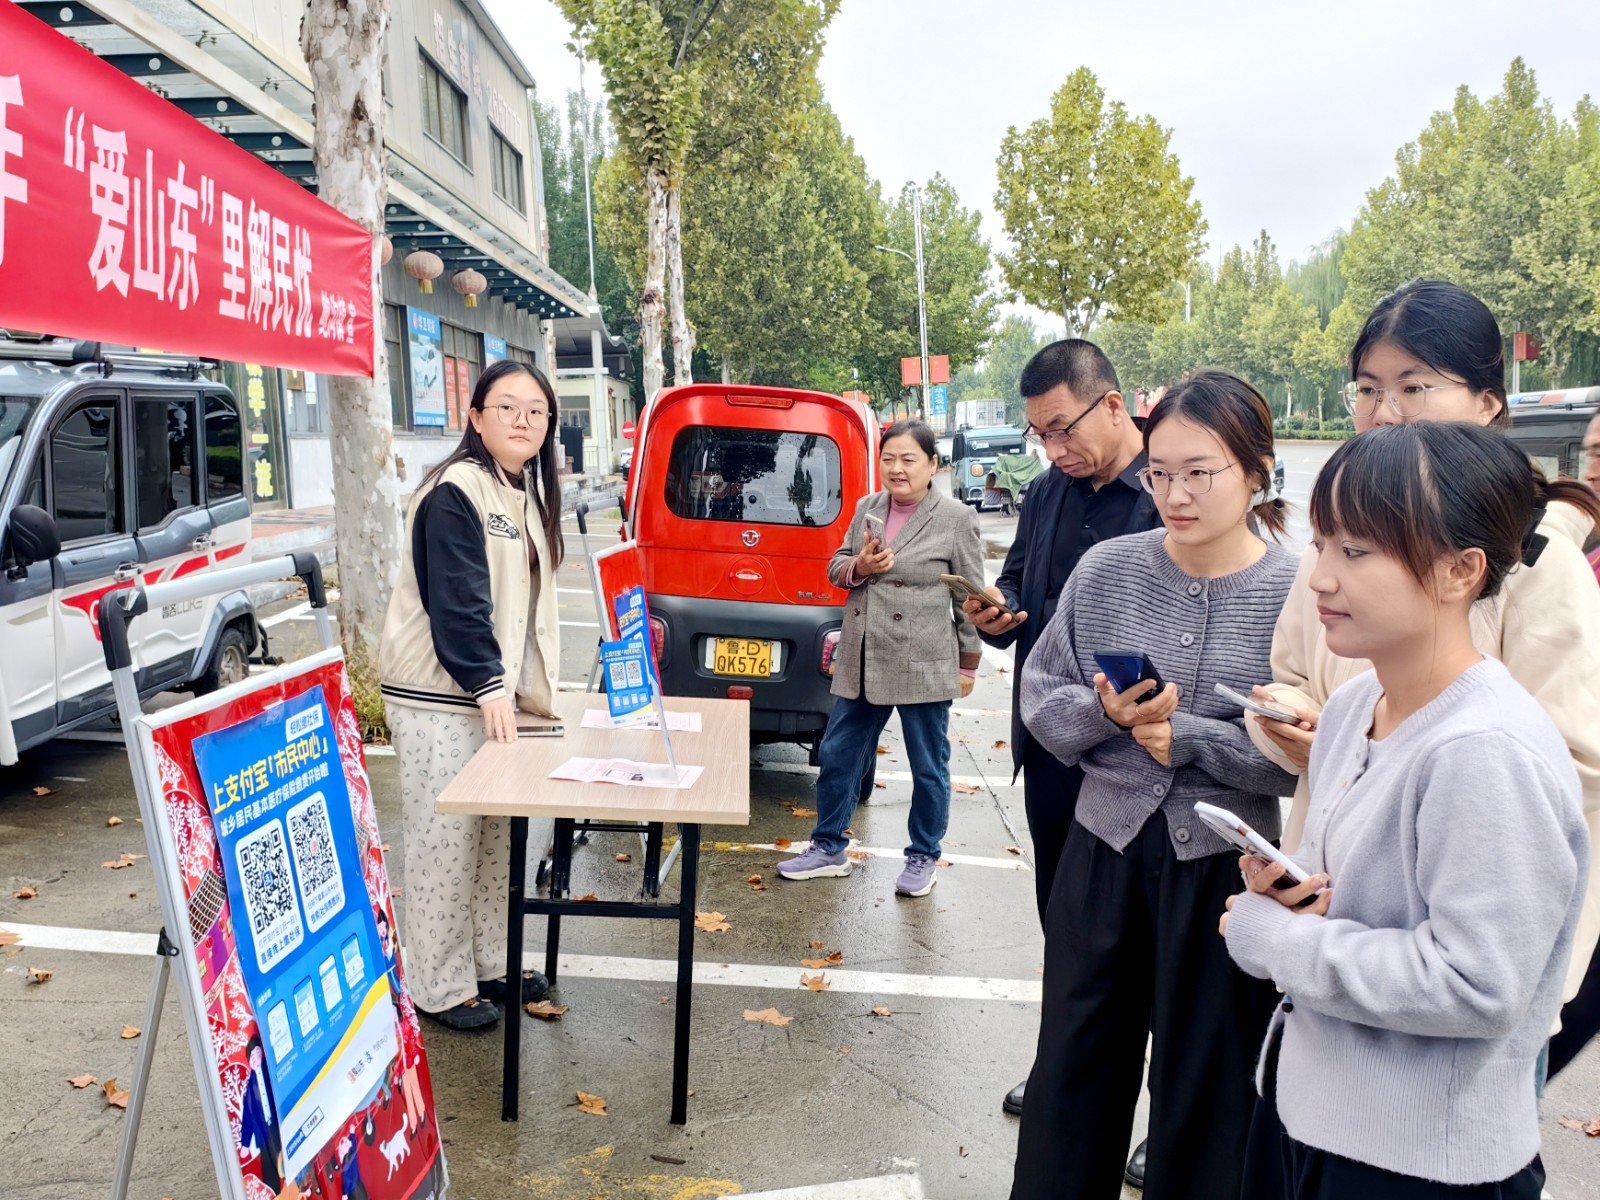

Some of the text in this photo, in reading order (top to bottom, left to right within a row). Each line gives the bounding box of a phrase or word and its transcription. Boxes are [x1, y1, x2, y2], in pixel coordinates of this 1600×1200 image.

[717, 655, 767, 674] QK576
[214, 732, 328, 815] 上支付宝「市民中心」
[220, 762, 329, 837] 城乡居民基本医疗保险缴费开始啦
